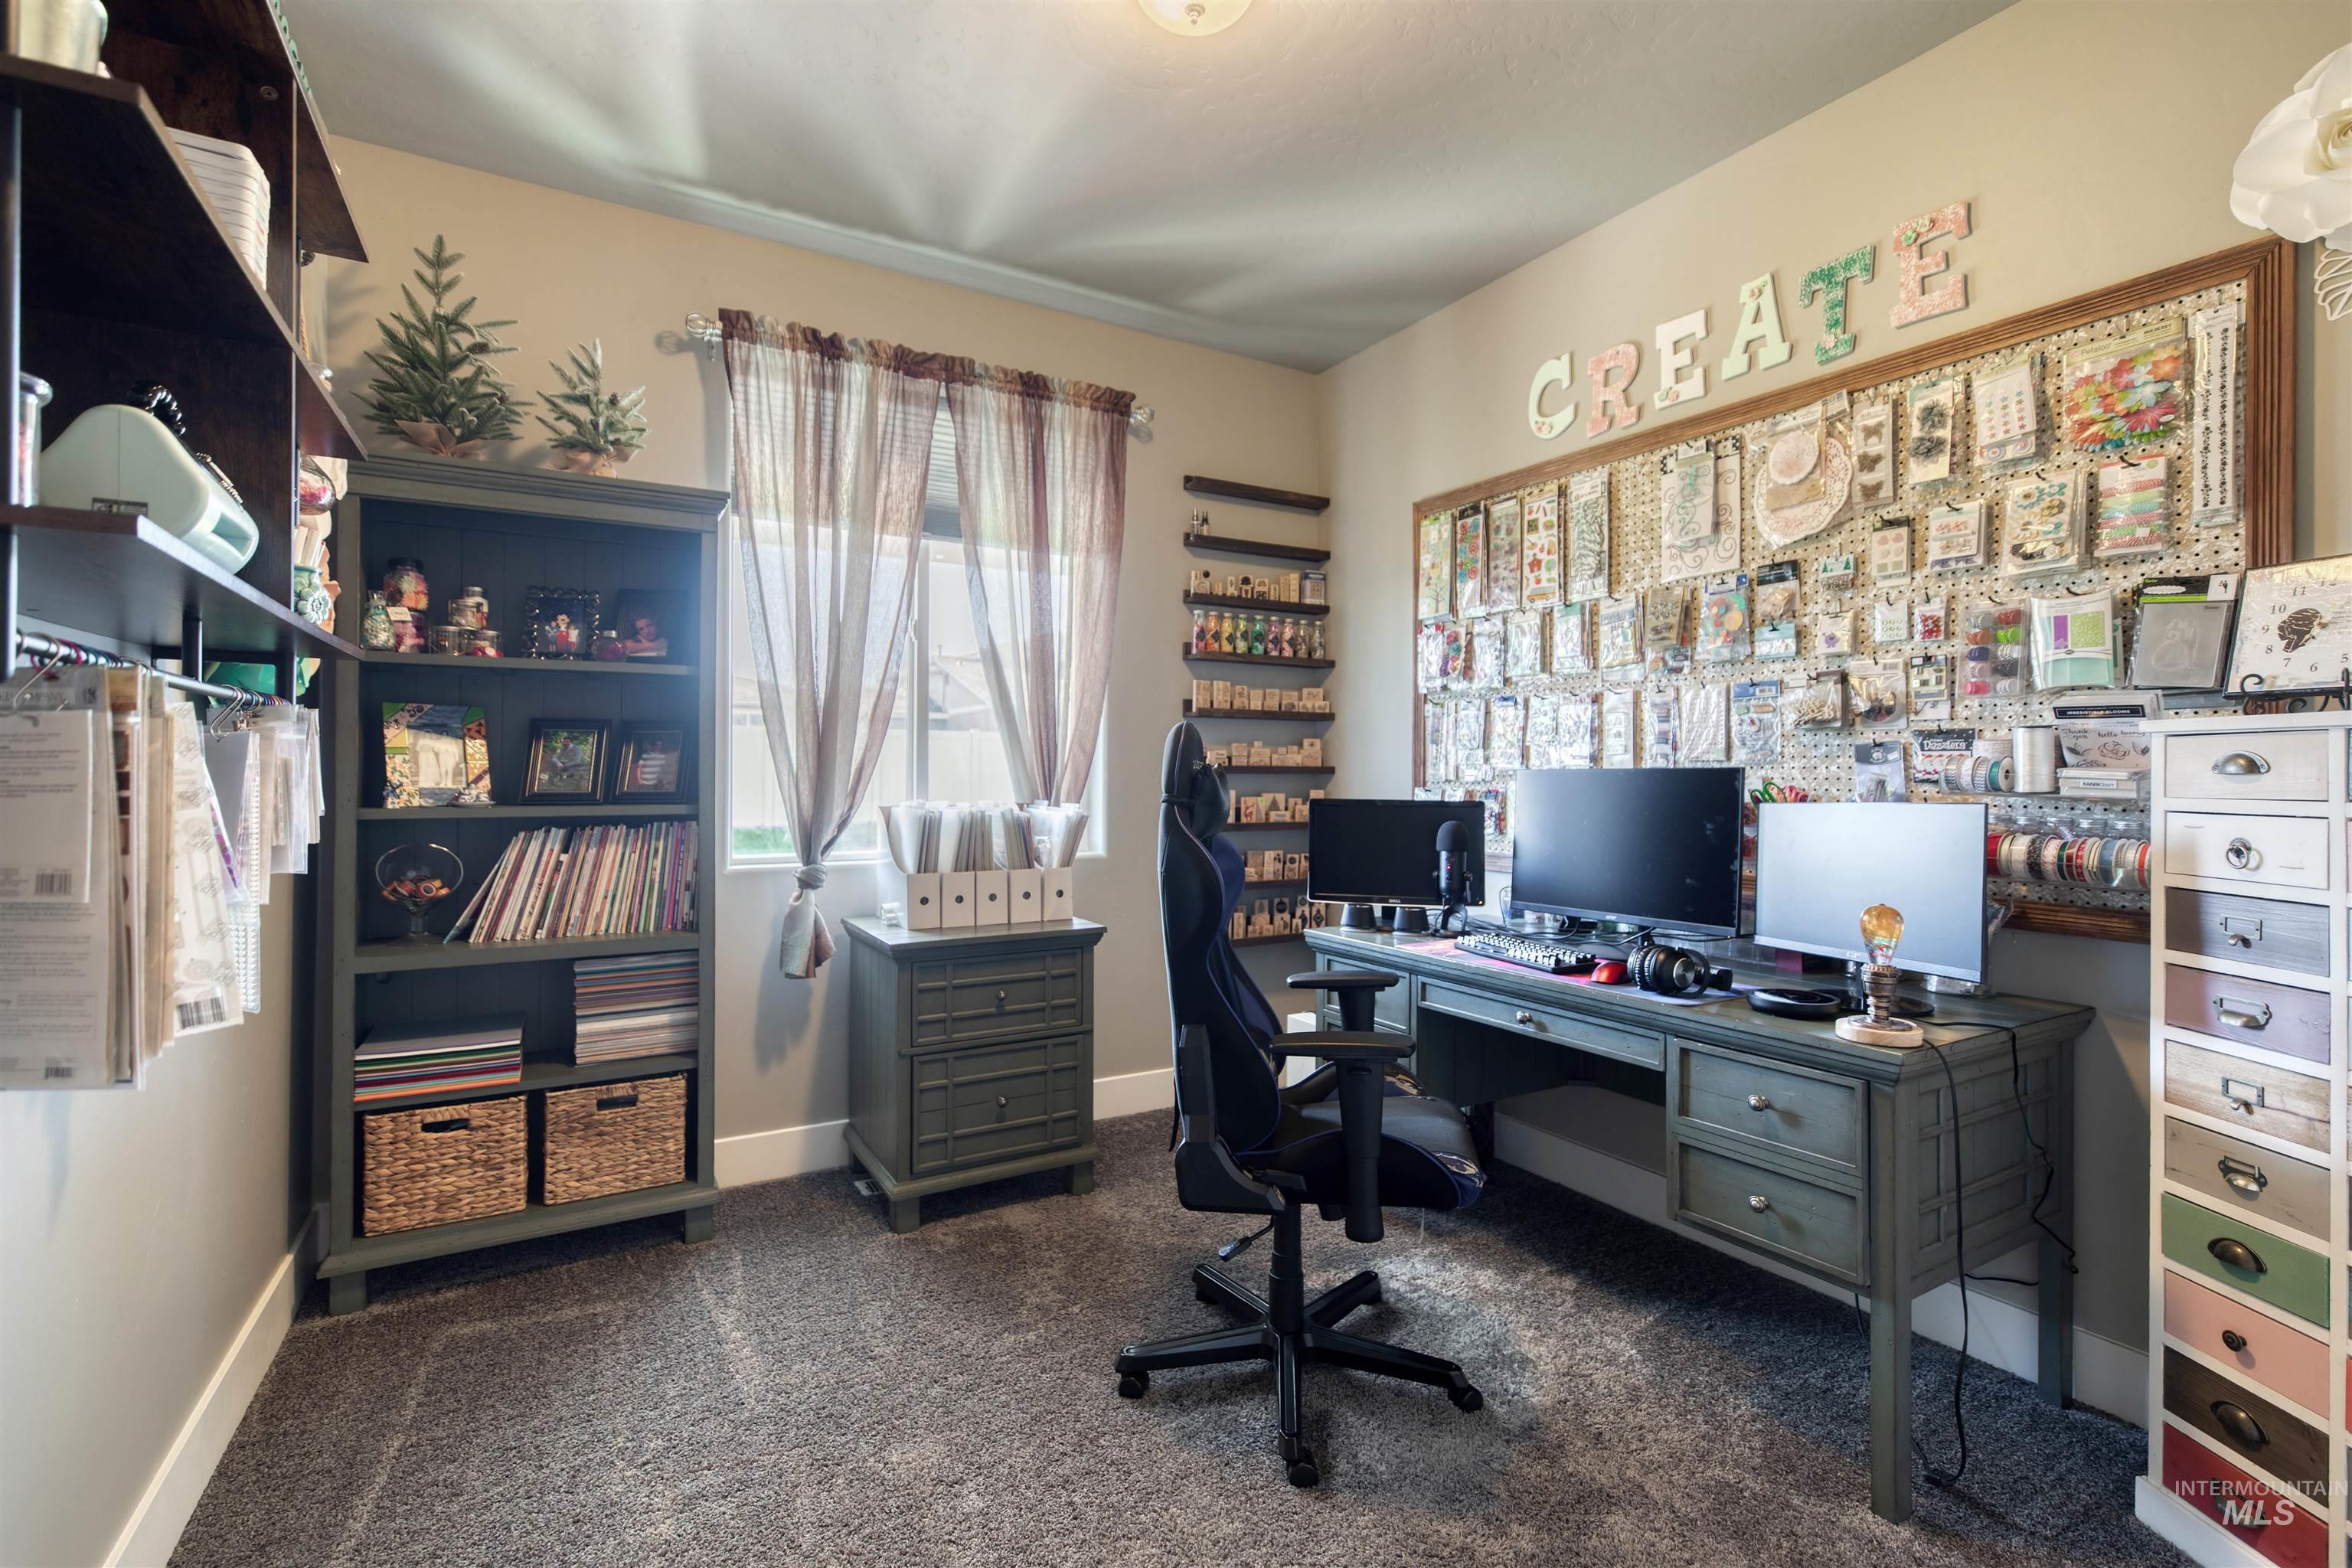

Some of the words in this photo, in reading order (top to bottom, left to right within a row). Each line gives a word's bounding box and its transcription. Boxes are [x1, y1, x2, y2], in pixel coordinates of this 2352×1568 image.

[1528, 201, 1971, 439] CREATE
[2291, 586, 2307, 596] 11
[2271, 603, 2287, 614] 10
[2261, 624, 2270, 635] 9
[2265, 645, 2273, 655] 8
[2283, 658, 2292, 668] 7
[2340, 653, 2349, 663] 5
[2309, 662, 2318, 672] 6
[1923, 740, 1967, 750] Dazzlers
